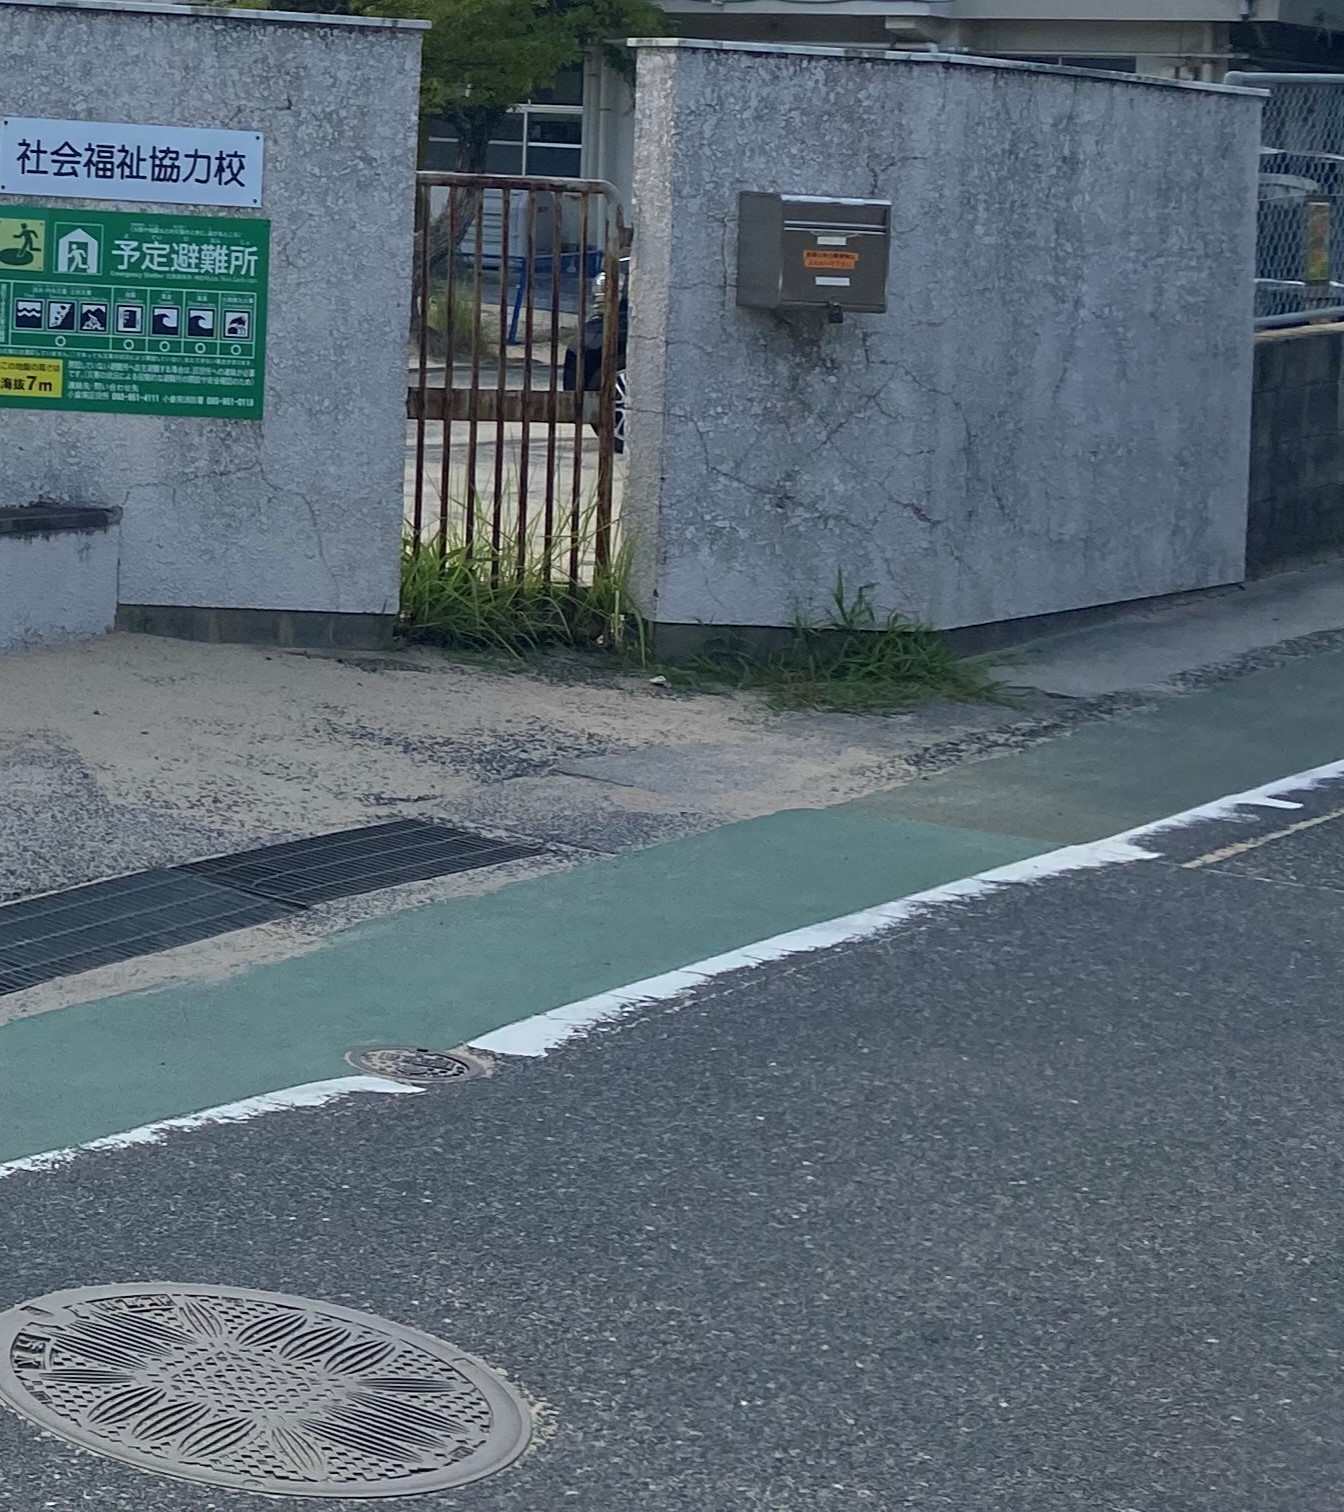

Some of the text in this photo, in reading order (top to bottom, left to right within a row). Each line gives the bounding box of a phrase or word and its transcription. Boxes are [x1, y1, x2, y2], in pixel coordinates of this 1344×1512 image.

[16, 138, 247, 187] 社会福祉協力校
[111, 239, 258, 277] 予定避難所
